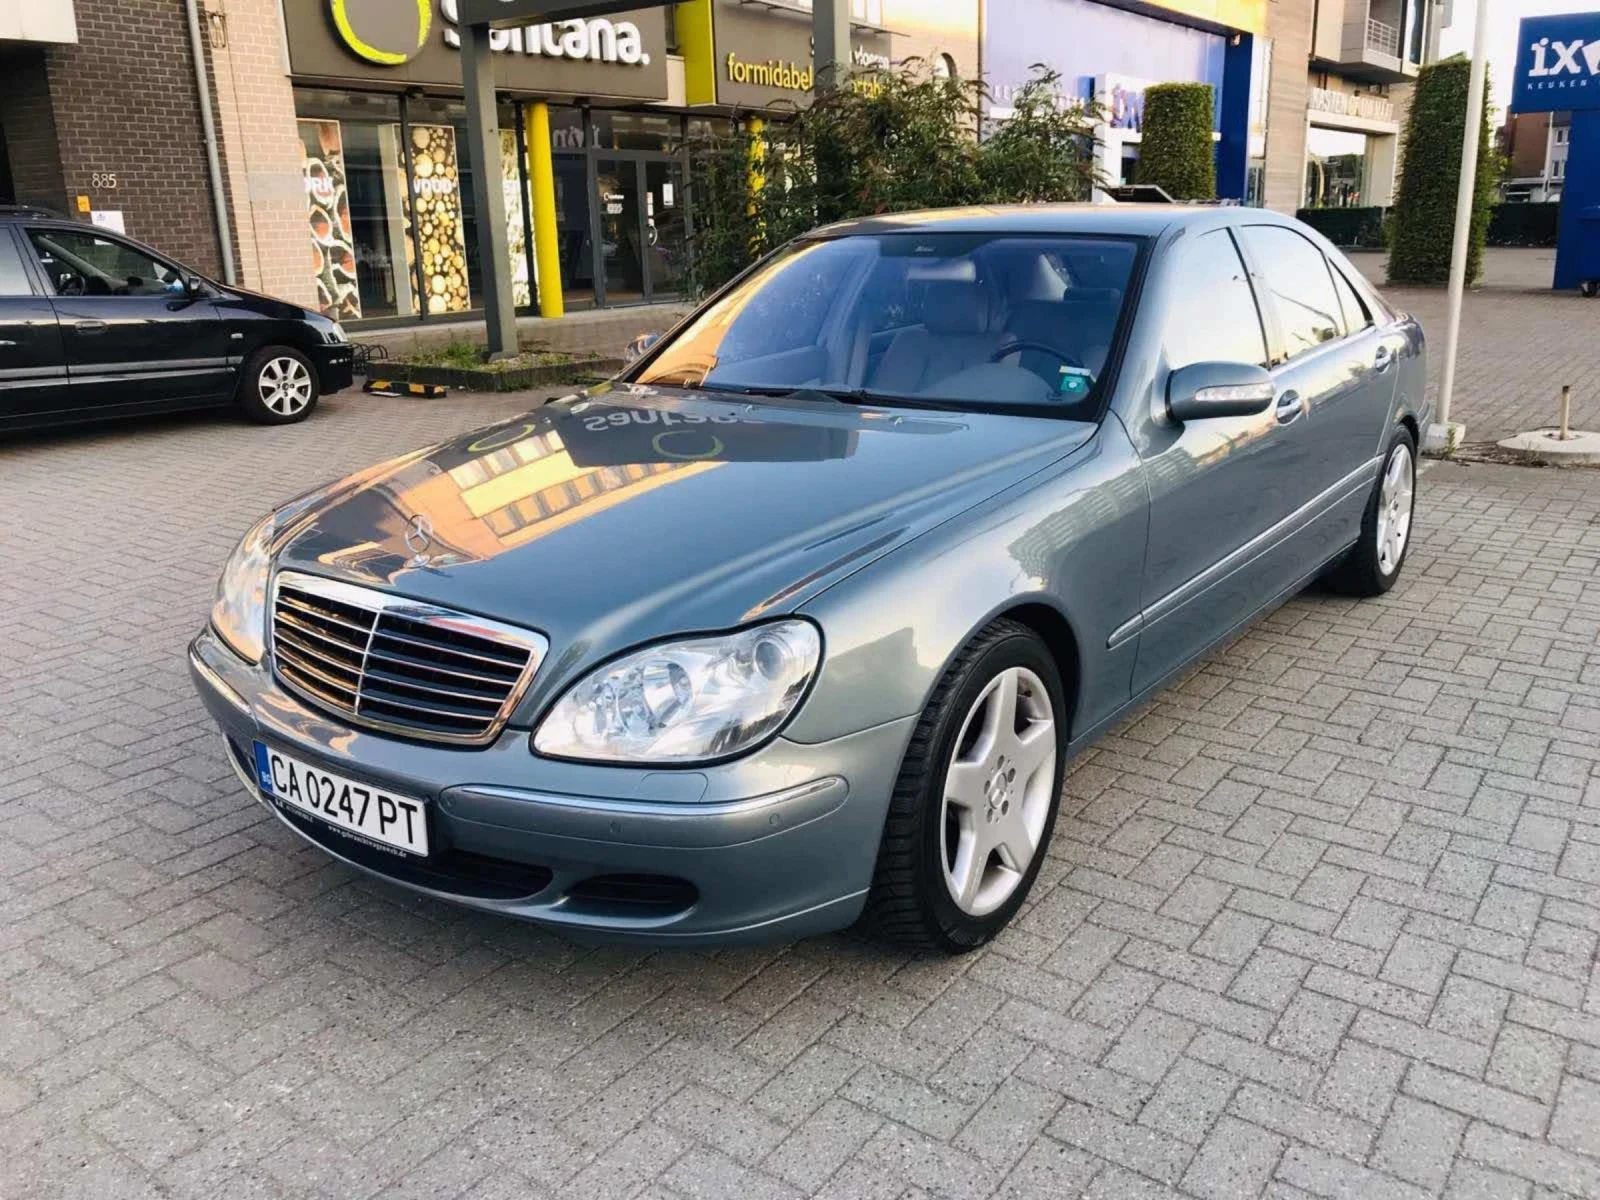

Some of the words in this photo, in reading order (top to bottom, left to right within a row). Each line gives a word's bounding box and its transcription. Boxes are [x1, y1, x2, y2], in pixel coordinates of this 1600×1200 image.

[728, 52, 813, 91] formidabel
[1527, 80, 1588, 91] KEUKEN
[92, 173, 117, 188] 885
